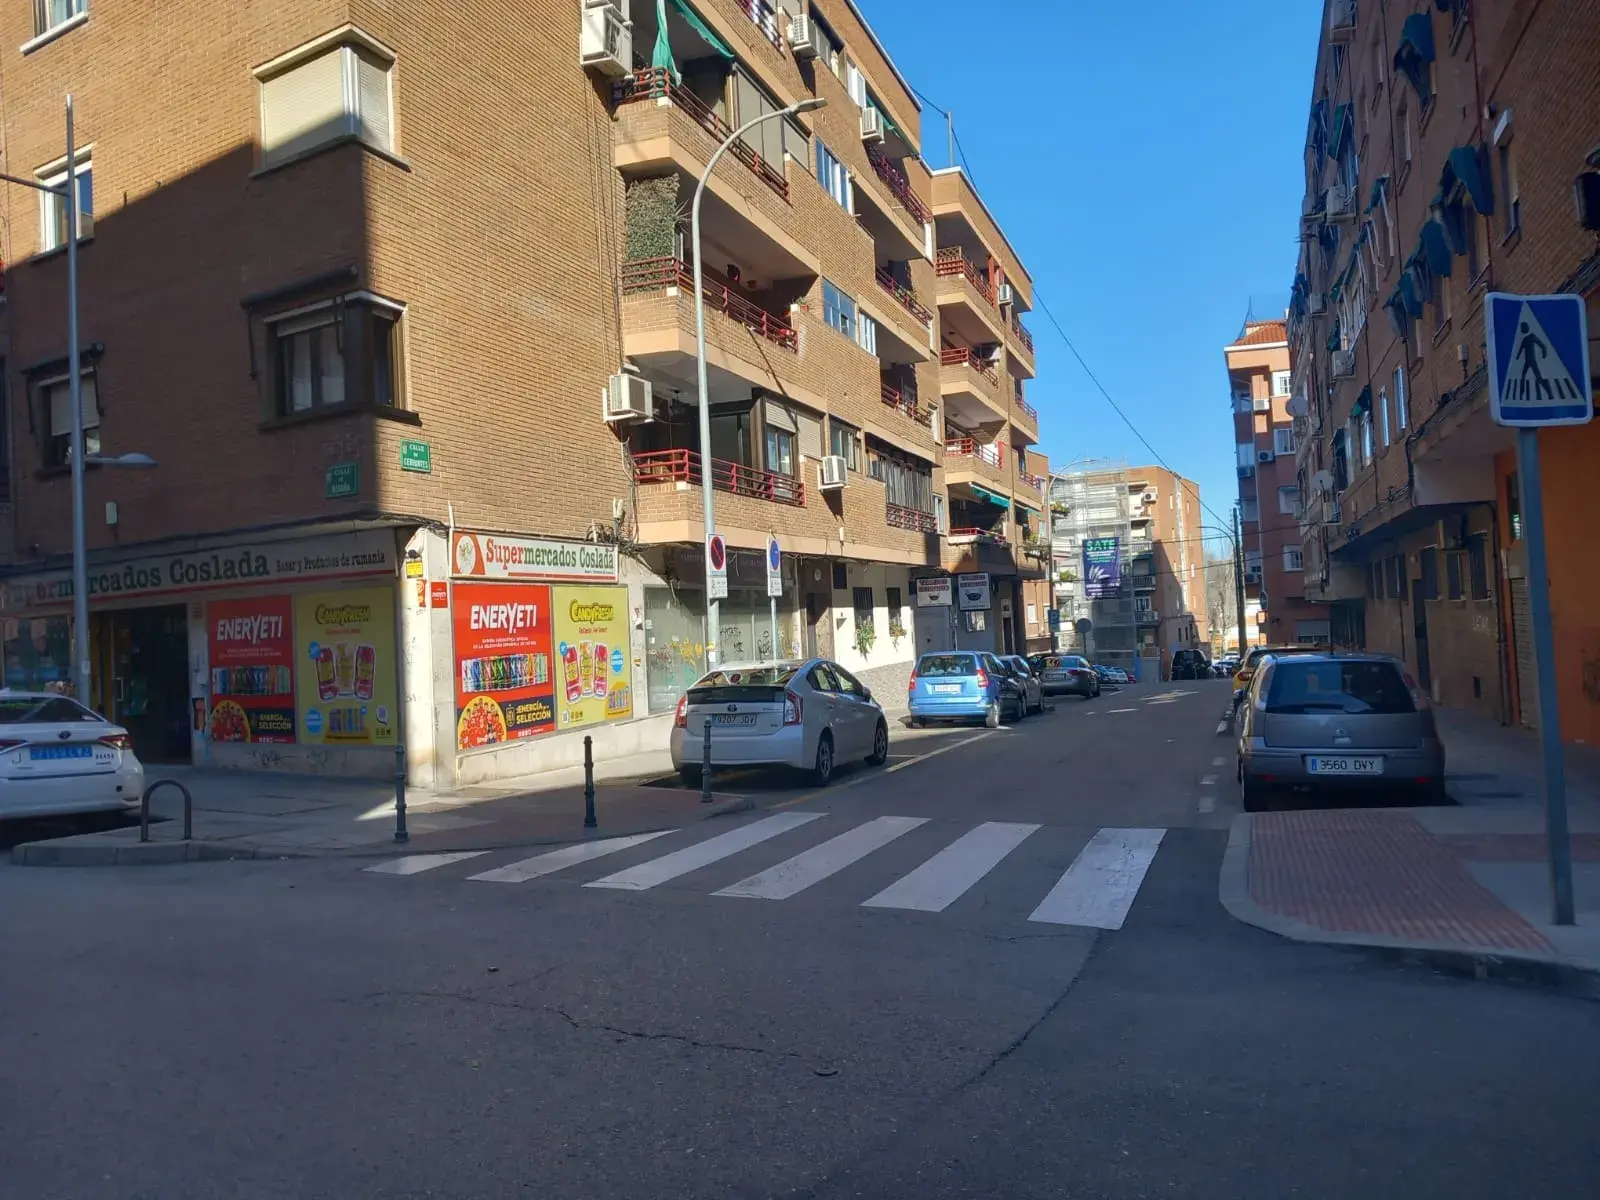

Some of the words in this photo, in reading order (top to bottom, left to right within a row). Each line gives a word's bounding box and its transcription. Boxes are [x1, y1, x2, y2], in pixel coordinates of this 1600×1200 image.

[409, 443, 425, 452] CALLE
[1086, 540, 1115, 551] SATE
[486, 538, 577, 570] Supermercados
[580, 546, 615, 570] Coslada
[0, 564, 162, 608] Supermrcados
[169, 550, 270, 585] Coslada
[303, 552, 339, 570] Productos
[340, 553, 350, 566] de
[470, 602, 537, 634] ENERYETI
[217, 614, 283, 645] ENERYETI
[516, 709, 552, 725] SELECCIÓN
[717, 714, 736, 725] 9207
[1320, 760, 1347, 771] 3560
[1354, 760, 1375, 771] DVY
